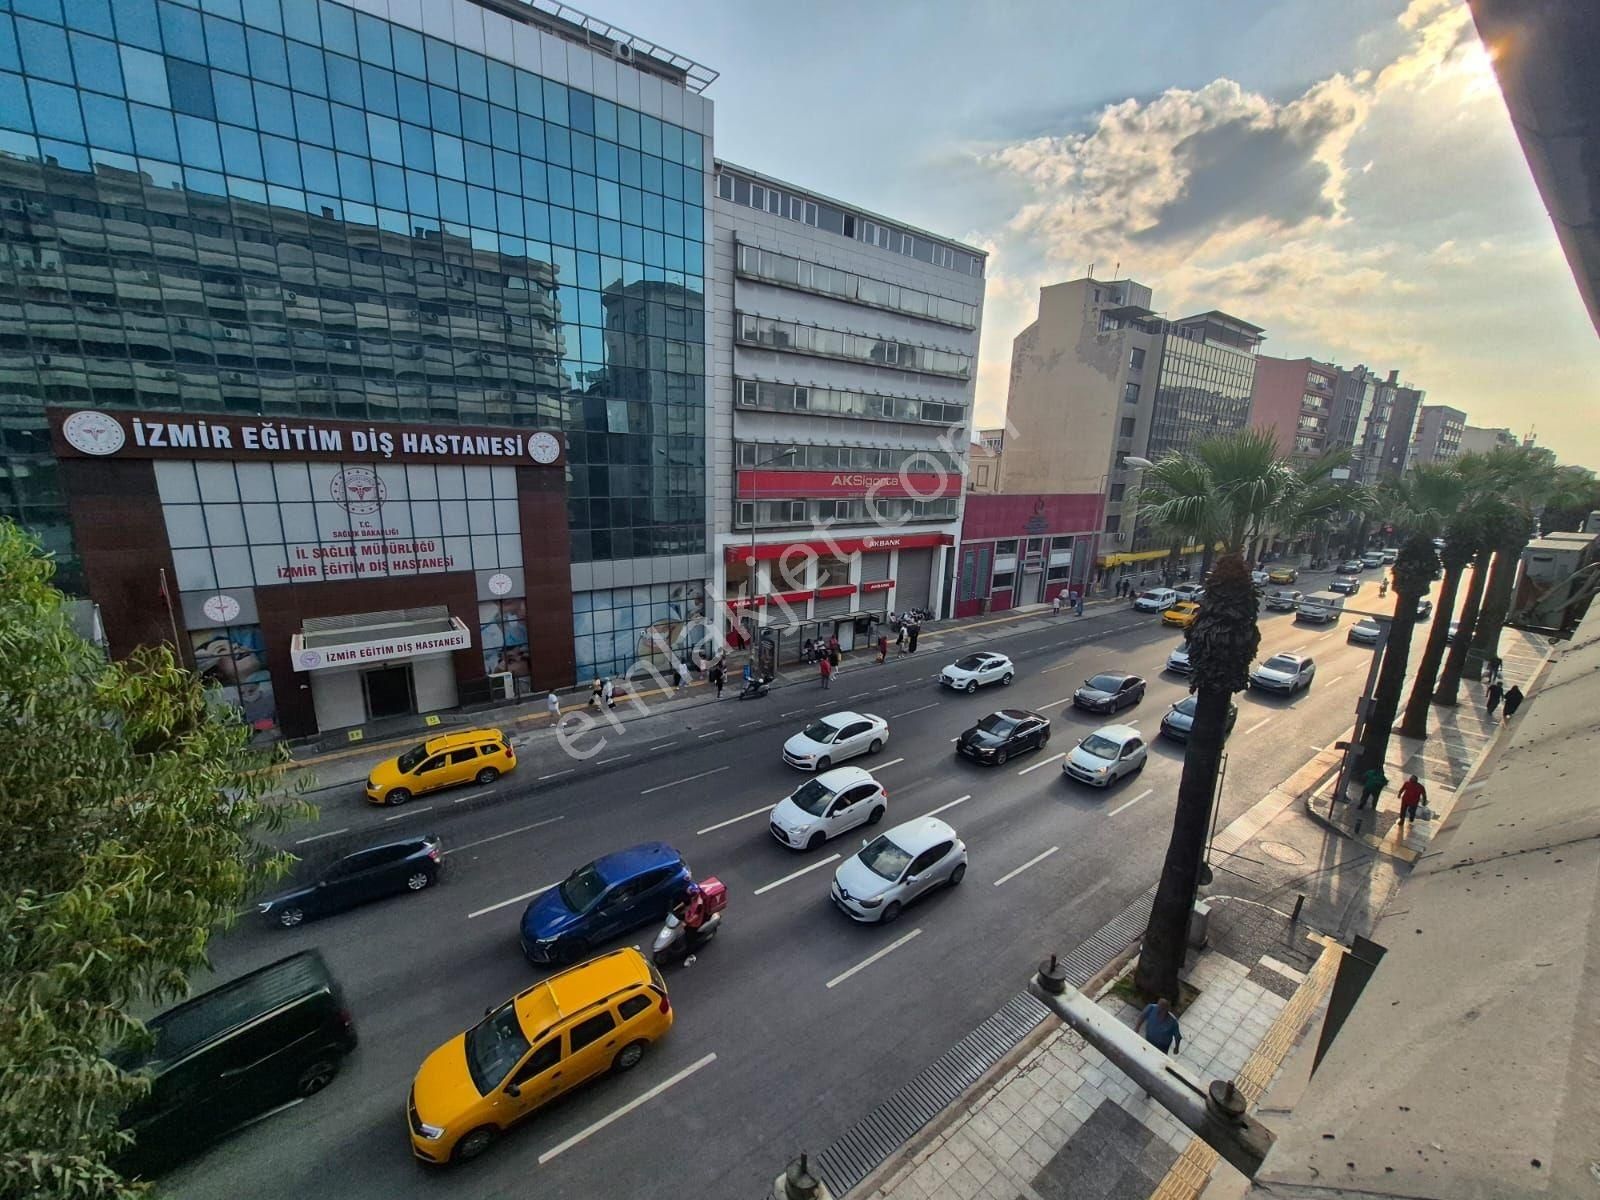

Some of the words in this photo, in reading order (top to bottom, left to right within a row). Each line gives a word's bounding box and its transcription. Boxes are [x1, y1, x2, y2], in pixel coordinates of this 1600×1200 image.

[132, 417, 233, 449] İZMİR
[241, 422, 343, 451] EĞİTİM
[351, 428, 394, 458] DİŞ
[402, 433, 524, 456] HASTANESİ
[332, 529, 360, 538] SAĞLIK
[361, 528, 399, 538] BAKANLIĞI
[869, 539, 901, 547] AKBANK
[295, 546, 309, 560] İL
[312, 544, 357, 559] SAĞLIK
[361, 540, 435, 556] MÜDÜRLÜĞÜ
[277, 565, 317, 579] İZMİR
[322, 560, 366, 575] EĞİTİM
[369, 560, 389, 574] DİŞ
[393, 555, 454, 571] HASTANESİ
[326, 650, 357, 663] İZMİR
[360, 644, 394, 658] EĞİTİM
[397, 642, 413, 653] DİŞ
[415, 637, 464, 650] HASTANESİ
